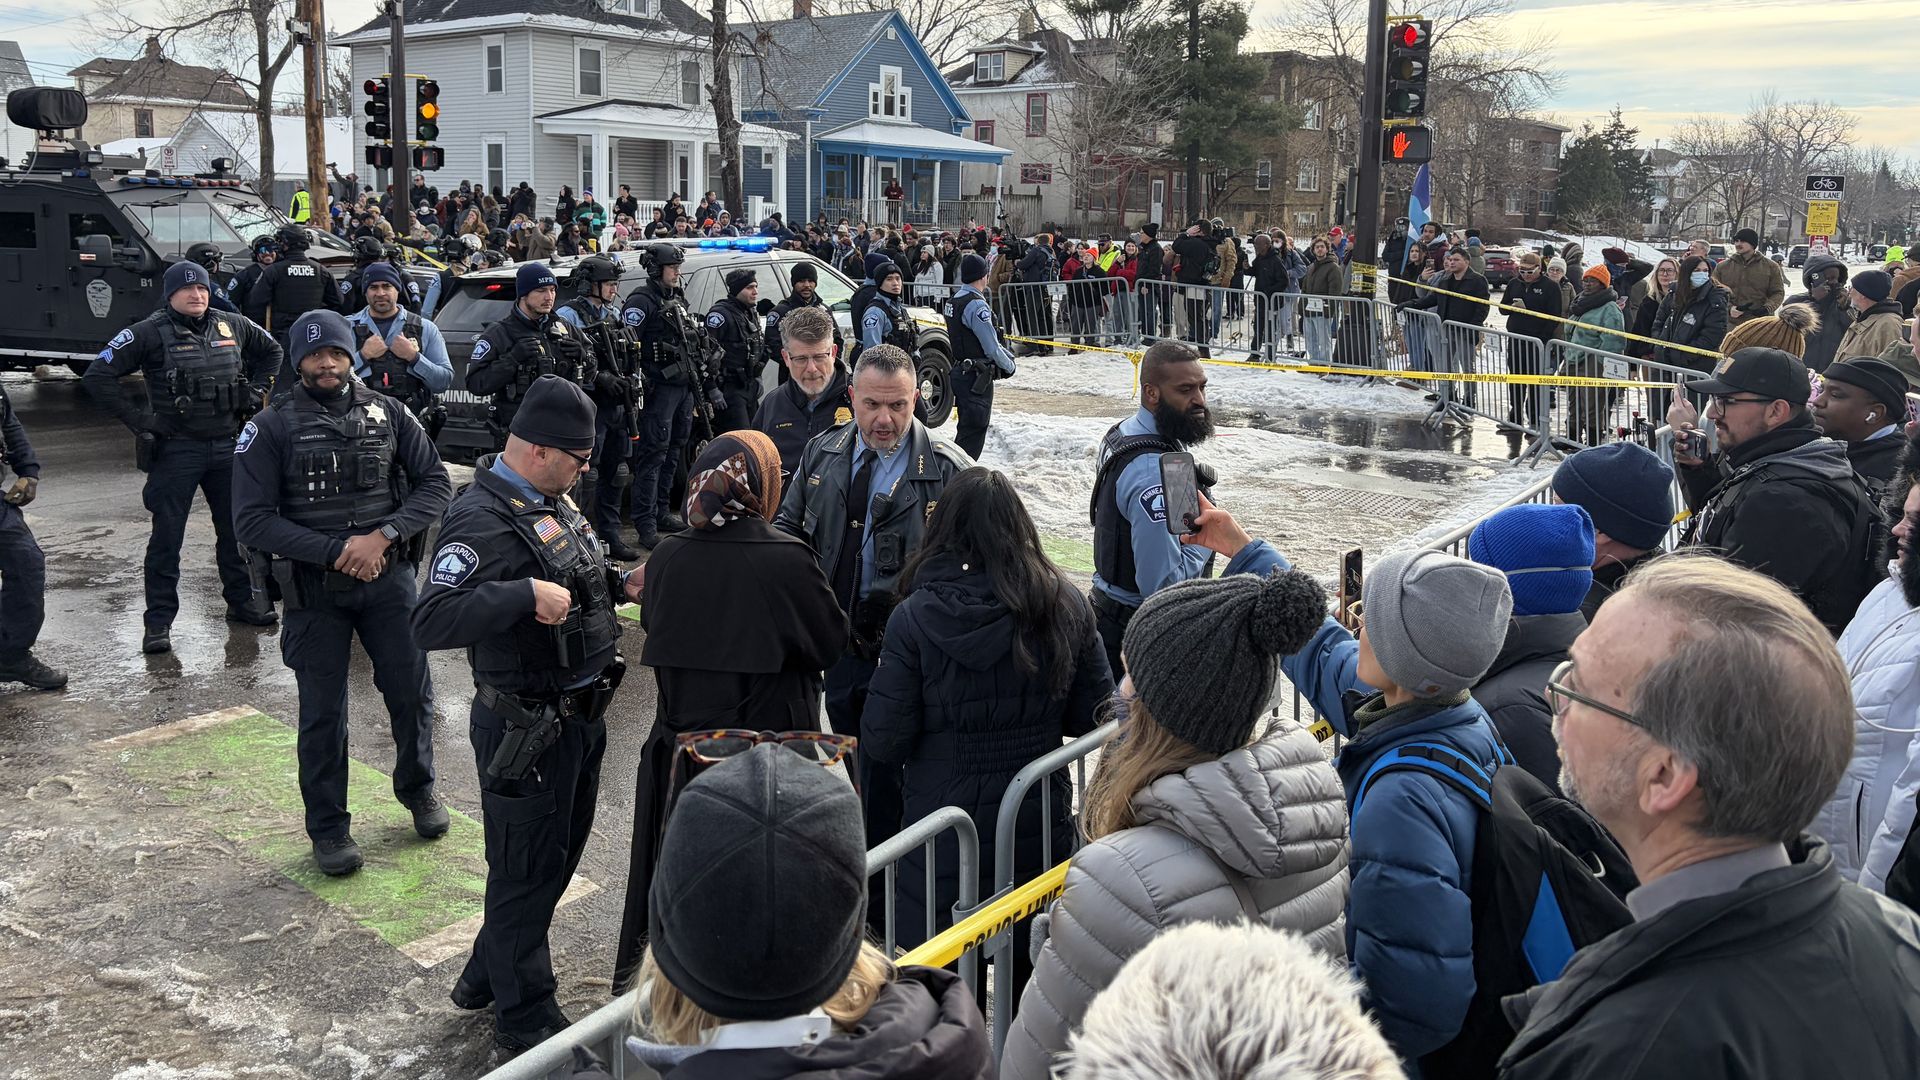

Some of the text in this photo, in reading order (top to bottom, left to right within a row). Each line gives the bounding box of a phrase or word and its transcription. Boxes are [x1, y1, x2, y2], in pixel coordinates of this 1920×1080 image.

[288, 267, 315, 276] POLICE
[141, 278, 153, 287] B1
[538, 276, 554, 284] MPD
[440, 389, 495, 404] MINNEA
[438, 545, 476, 564] MINNEAPOLIS
[434, 573, 457, 583] POLICE
